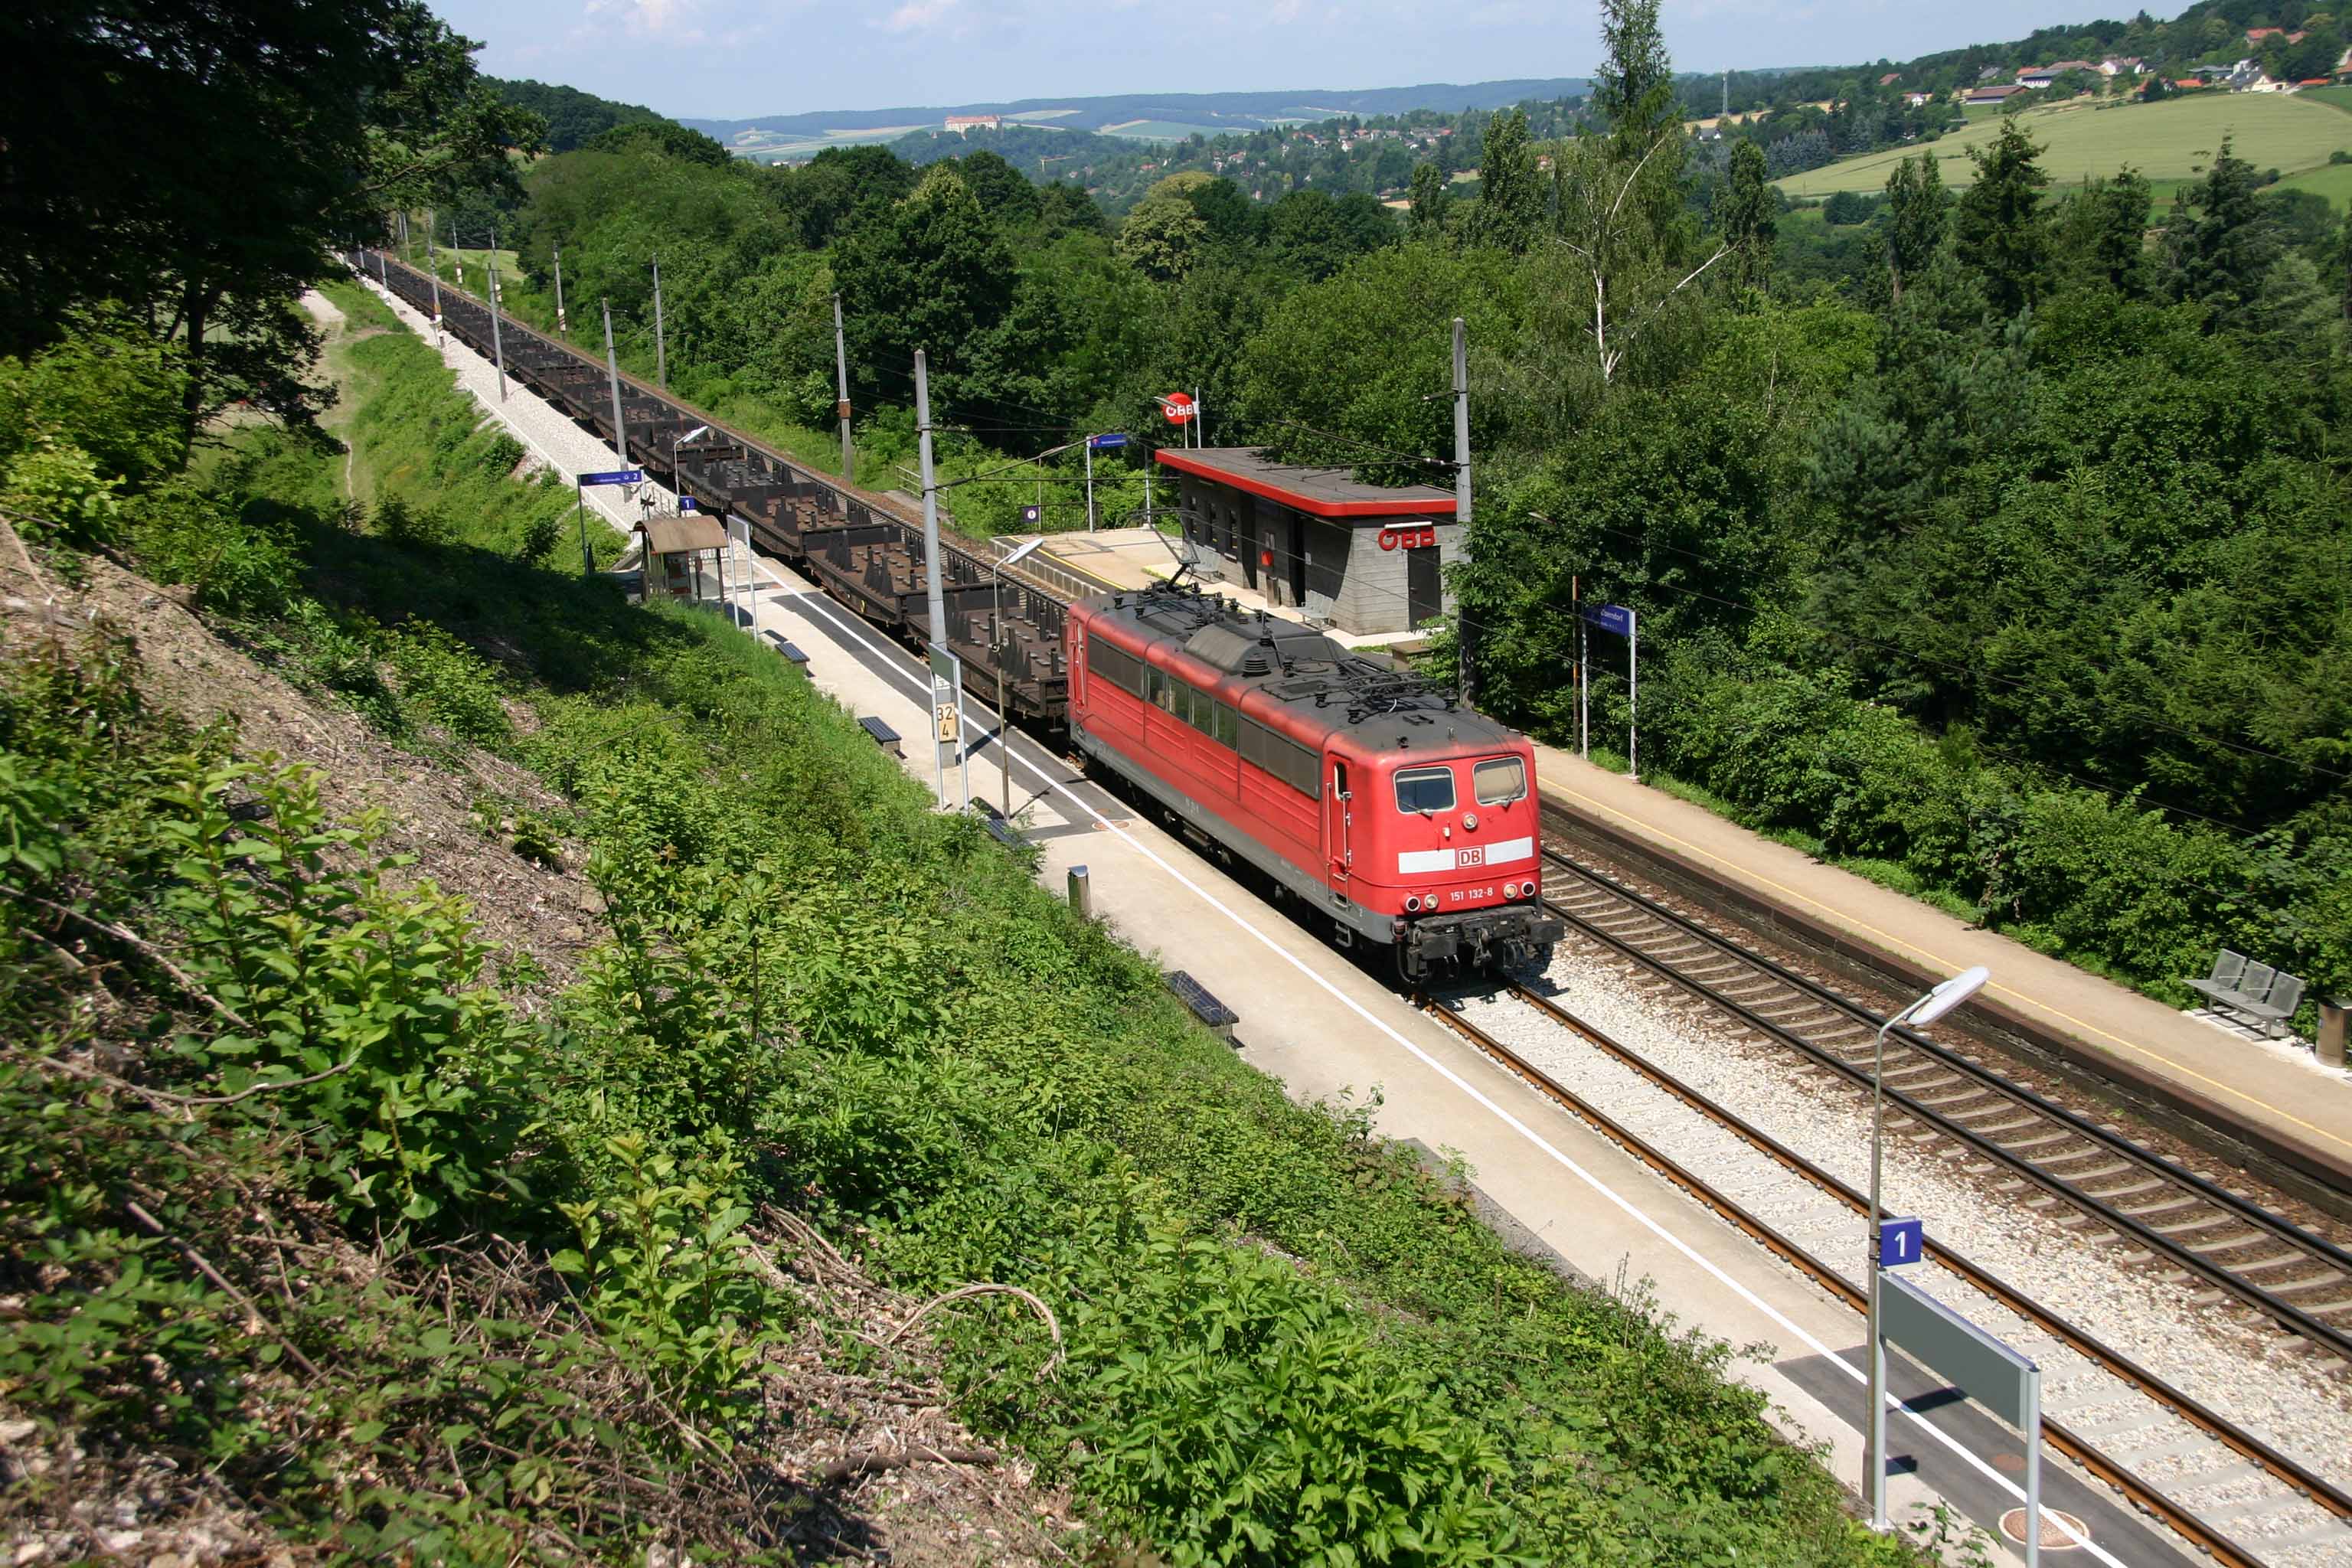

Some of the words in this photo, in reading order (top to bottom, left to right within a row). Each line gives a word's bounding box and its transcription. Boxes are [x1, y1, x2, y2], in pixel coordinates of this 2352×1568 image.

[684, 498, 690, 508] 1
[942, 724, 949, 737] 4
[1460, 850, 1480, 864] DB
[1450, 890, 1464, 902] 151
[1468, 887, 1494, 900] 132-8
[1894, 1230, 1906, 1257] 1
